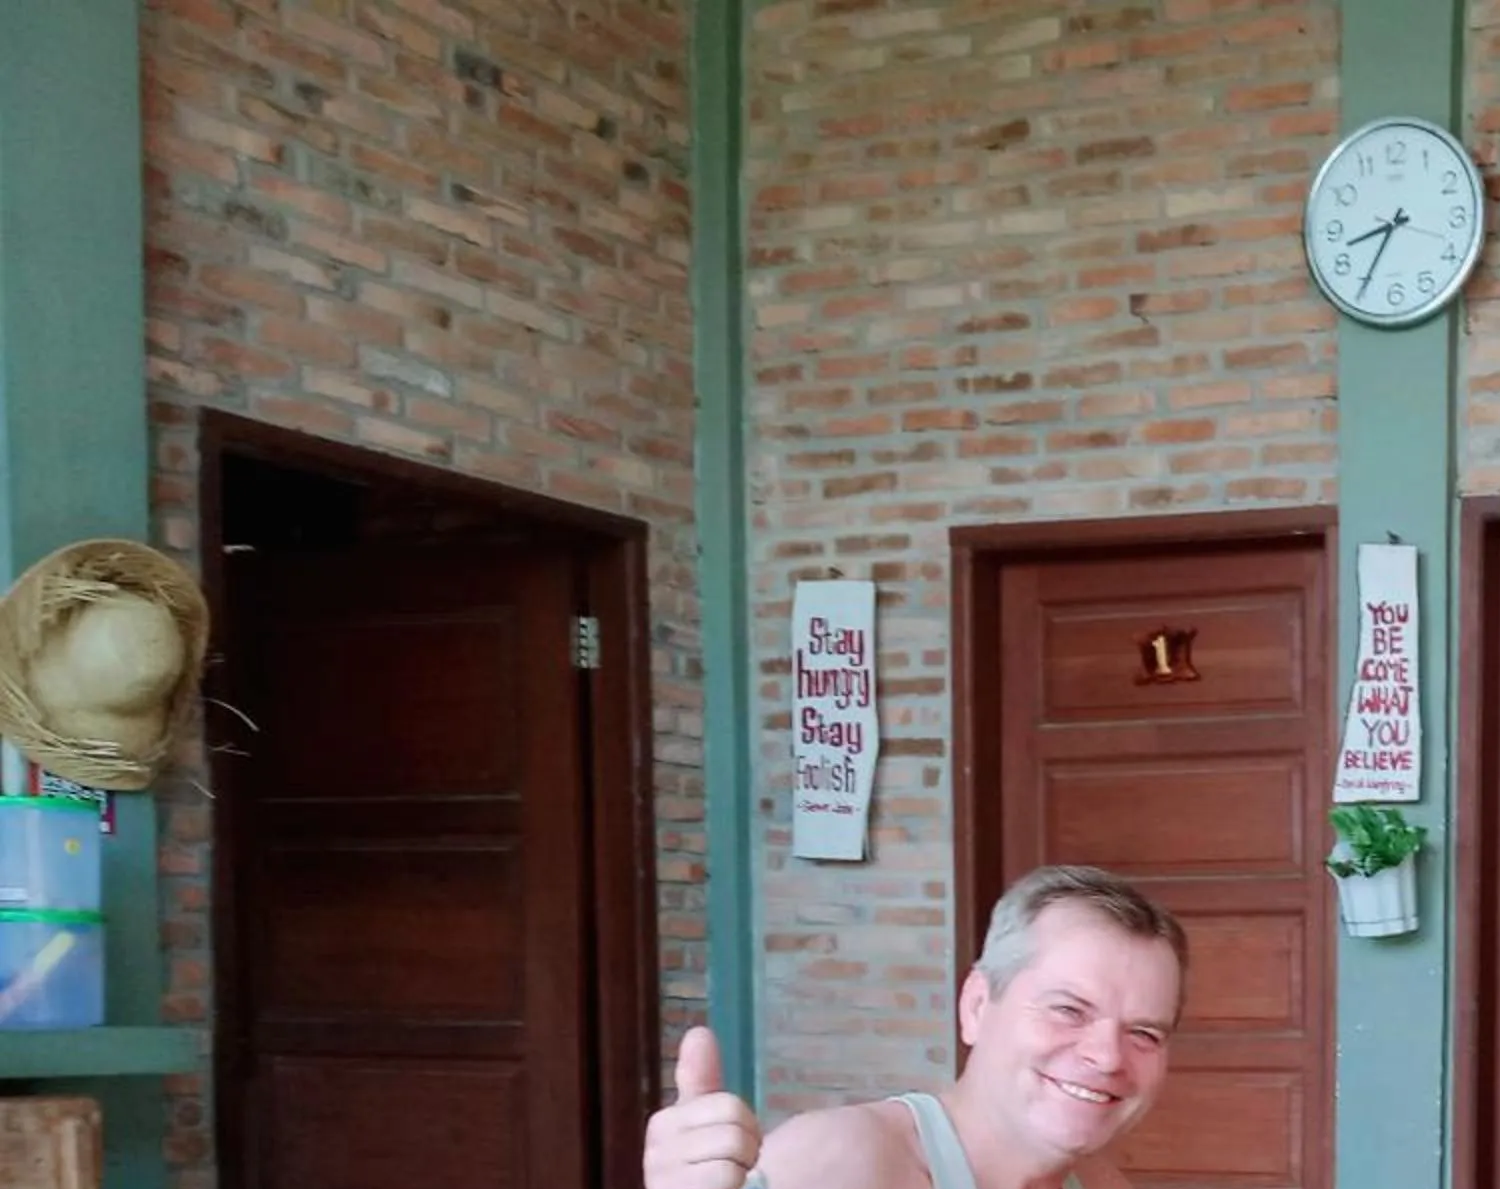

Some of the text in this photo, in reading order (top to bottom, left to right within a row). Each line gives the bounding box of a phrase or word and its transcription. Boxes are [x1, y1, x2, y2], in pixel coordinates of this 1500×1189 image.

[1356, 152, 1374, 177] 11
[1385, 141, 1407, 165] 12
[1332, 183, 1358, 207] 10
[1441, 170, 1458, 195] 2
[1450, 205, 1467, 230] 3
[1326, 219, 1344, 243] 9
[1335, 253, 1352, 277] 8
[1440, 243, 1458, 265] 4
[1387, 283, 1405, 307] 6
[1417, 271, 1436, 294] 5
[1367, 601, 1409, 626] YOU
[809, 617, 865, 668] Stay
[1374, 627, 1405, 656] BE
[1152, 635, 1173, 675] 1
[1358, 686, 1413, 717] WHAT
[802, 707, 863, 756] Stay
[1361, 720, 1410, 749] YOU
[1345, 751, 1413, 772] BELIEVE
